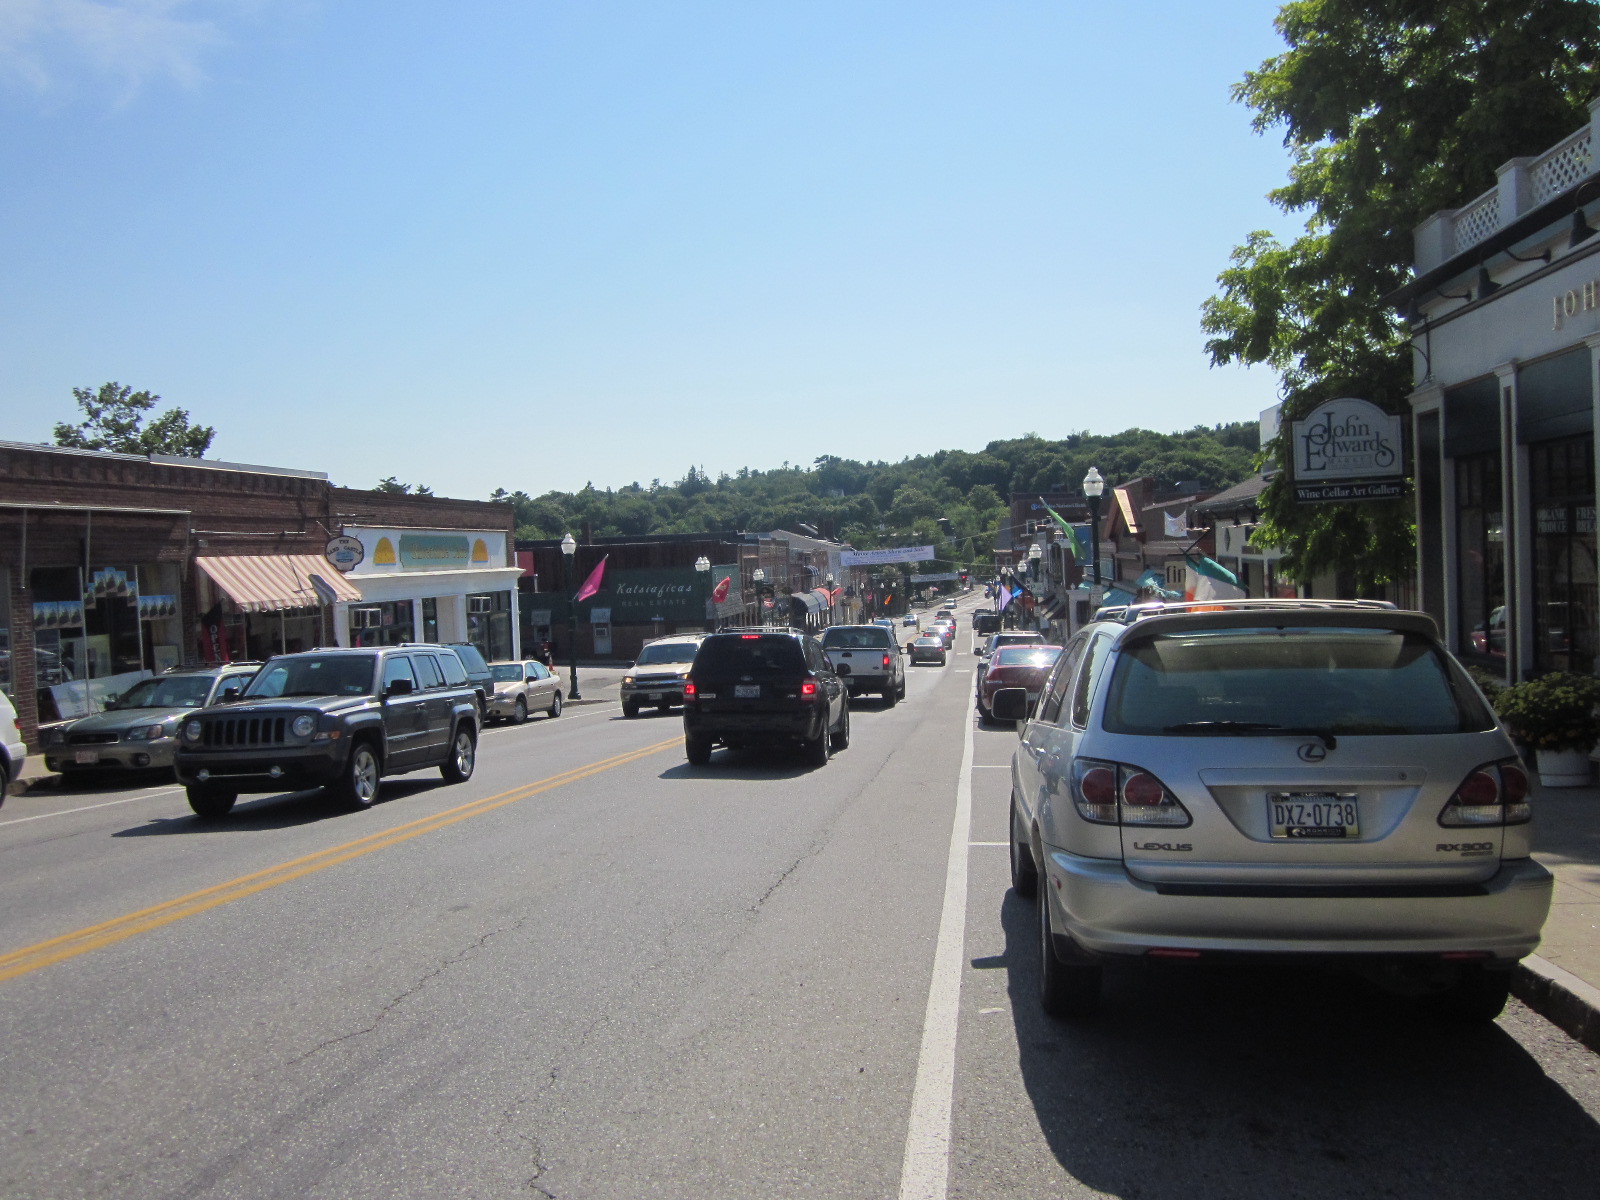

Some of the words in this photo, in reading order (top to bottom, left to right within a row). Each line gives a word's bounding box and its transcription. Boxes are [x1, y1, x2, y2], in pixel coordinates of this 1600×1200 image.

[1309, 411, 1370, 446] John
[1301, 431, 1395, 471] Edwards
[1297, 488, 1320, 499] Wine
[1322, 486, 1350, 498] Cellar
[1351, 485, 1367, 496] Art
[1368, 484, 1400, 495] Gallery
[210, 624, 222, 662] OPEN
[1133, 842, 1193, 851] LEXUS
